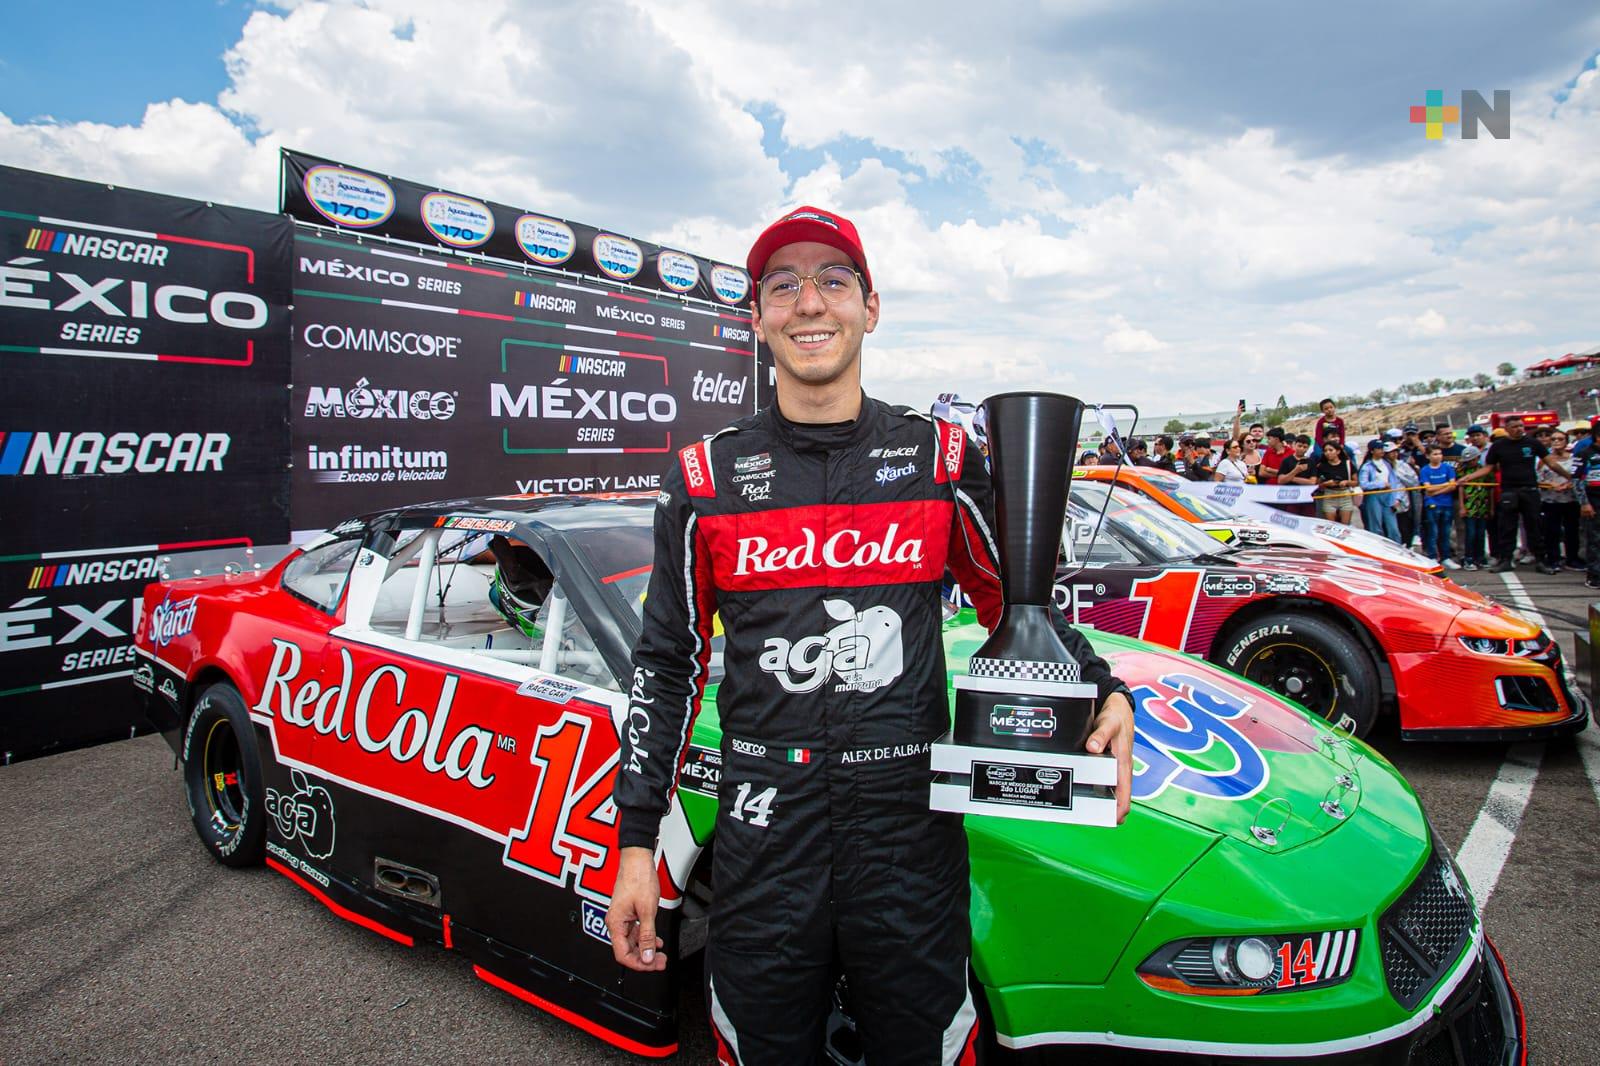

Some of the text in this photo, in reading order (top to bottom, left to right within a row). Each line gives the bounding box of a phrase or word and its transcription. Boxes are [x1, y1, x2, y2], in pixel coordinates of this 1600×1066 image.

[331, 201, 369, 220] 170
[442, 224, 474, 241] 170
[63, 233, 169, 266] NASCAR
[531, 243, 559, 259] 170
[300, 257, 462, 295] MÉXICO SERIES
[606, 260, 629, 275] 170
[0, 256, 268, 329] ÉXICO
[669, 274, 688, 287] 170
[529, 294, 686, 331] NASCAR MÉXICO SERIES
[60, 322, 141, 344] SERIES
[304, 324, 458, 358] COMMSCOPE
[722, 324, 750, 342] NASCAR
[576, 356, 626, 378] NASCAR
[304, 377, 455, 420] MÉXICO
[692, 370, 748, 405] telcel
[490, 378, 677, 422] MÉXICO
[576, 427, 615, 442] SERIES
[23, 431, 231, 475] NASCAR
[308, 445, 448, 470] infinitum
[882, 444, 919, 458] telcel
[684, 447, 704, 488] sparco
[735, 457, 771, 470] MÉXICO
[874, 461, 917, 485] Starch
[339, 469, 447, 483] Exceso de Velocidad
[614, 474, 660, 490] LANE
[740, 480, 771, 497] Red
[748, 493, 769, 502] Cola
[733, 522, 925, 576] Red Cola
[1206, 581, 1253, 591] MÉXICO
[149, 595, 198, 648] Starch
[1129, 568, 1207, 652] 1
[1226, 623, 1293, 668] GENERAL
[1505, 637, 1515, 657] 1
[758, 634, 872, 694] aga
[526, 683, 567, 699] RACE CAR
[834, 678, 883, 693] manzana
[252, 638, 517, 788] Red Cola MR
[992, 715, 1054, 729] MÉXICO
[628, 706, 651, 775] Cola
[732, 738, 766, 756] sparco
[841, 748, 872, 764] ALEX
[874, 746, 891, 760] DE
[893, 743, 921, 758] ALBA
[1000, 785, 1040, 795] 2do LUGAR
[264, 787, 317, 841] aga
[502, 710, 660, 906] 14
[729, 782, 778, 828] 14
[265, 842, 331, 888] racing team
[1277, 937, 1318, 989] 14
